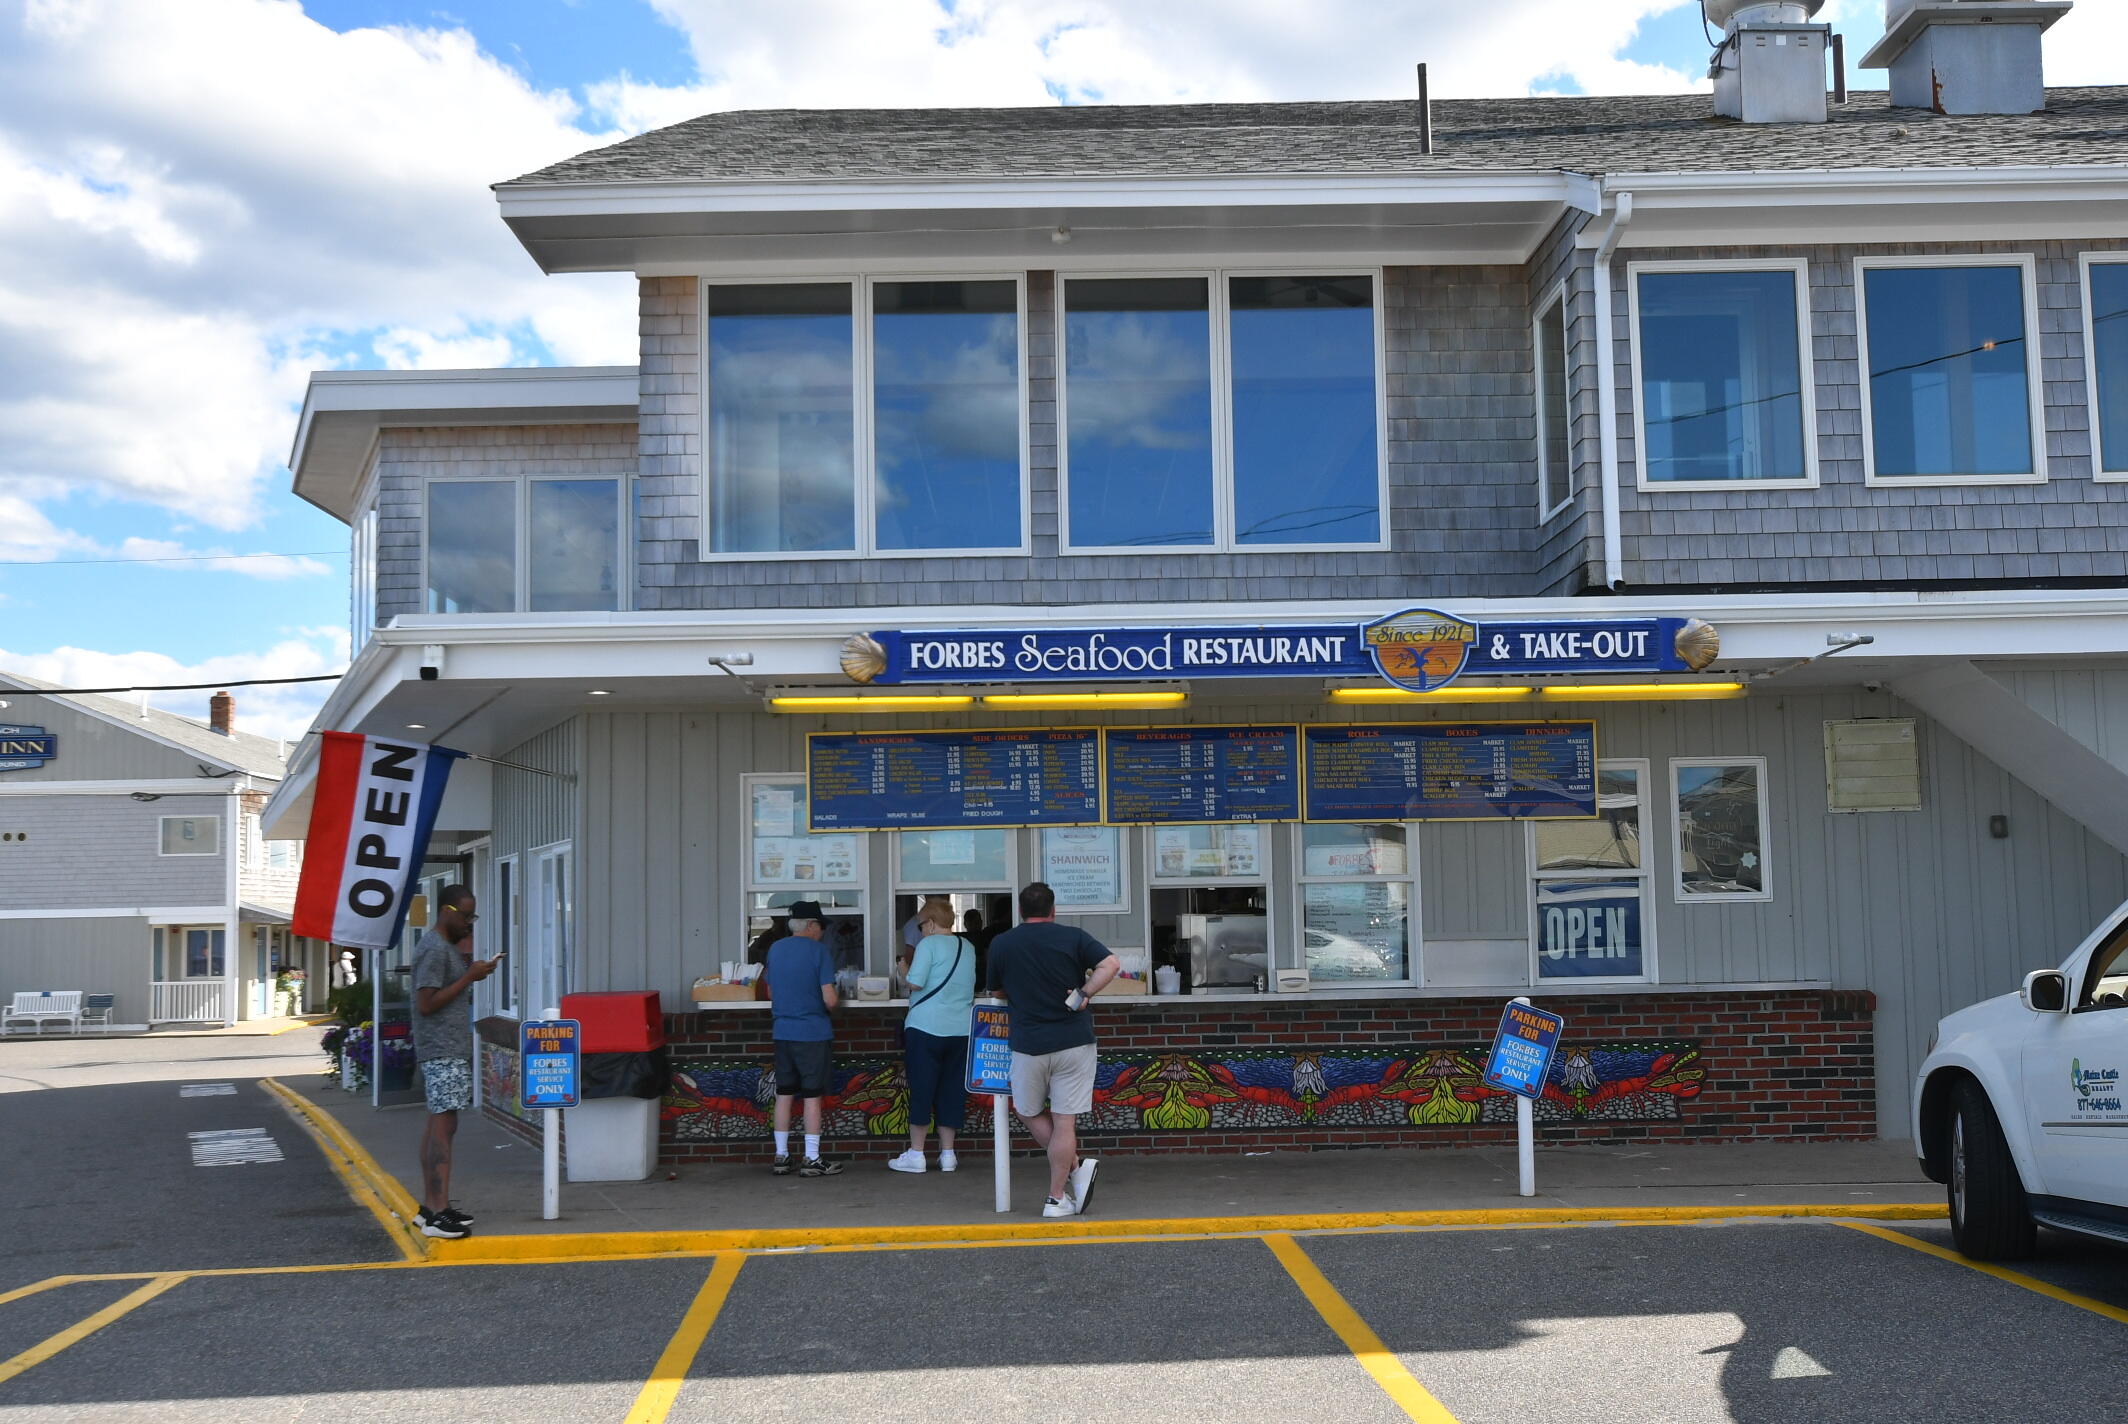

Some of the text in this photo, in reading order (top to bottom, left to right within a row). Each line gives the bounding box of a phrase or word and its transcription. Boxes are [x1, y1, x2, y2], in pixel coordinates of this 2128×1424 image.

[1376, 623, 1465, 642] Since 1921
[910, 631, 1649, 672] FORBES Seafood RESTAURANT & TAKE-OUT
[1526, 728, 1571, 736] DINNERS
[0, 741, 46, 754] INN
[349, 743, 418, 918] OPEN
[1050, 855, 1110, 865] SHAINWICH
[1546, 907, 1626, 960] OPEN
[977, 1011, 1009, 1024] PARKI
[1509, 1009, 1556, 1033] PARKING
[526, 1027, 573, 1039] PARKING
[989, 1025, 1009, 1037] FOR
[1518, 1025, 1540, 1041] FOR
[540, 1040, 560, 1052] FOR
[981, 1043, 1010, 1053] FORBE
[1507, 1040, 1541, 1058] FORBES
[976, 1052, 1011, 1060] RESTAURA
[1500, 1048, 1541, 1067] RESTAURANT
[534, 1058, 567, 1068] FORBES
[983, 1060, 1010, 1069] SERVICE
[1505, 1058, 1532, 1072] SERVICE
[981, 1069, 1009, 1080] ONLY
[1501, 1065, 1530, 1082] ONLY
[2083, 1069, 2119, 1081] Maine Castle
[535, 1084, 565, 1094] ONLY
